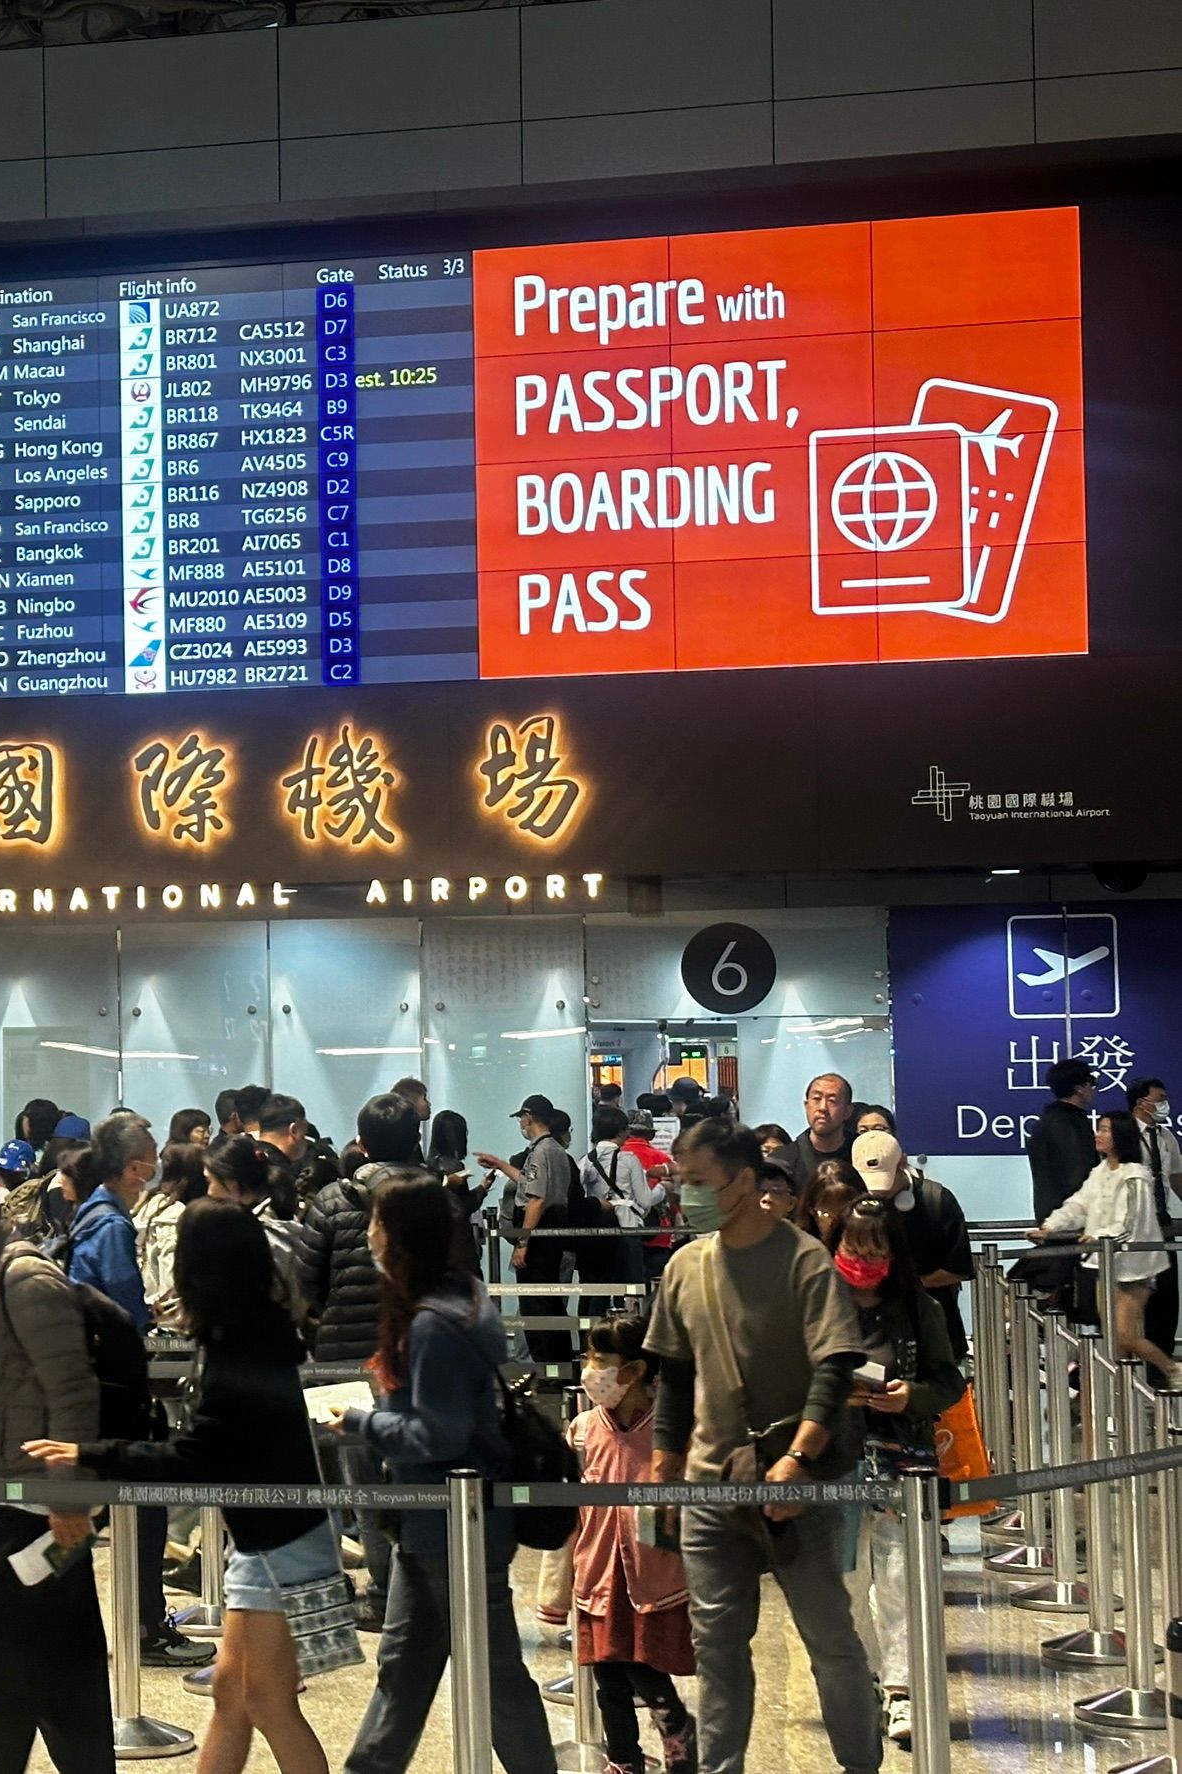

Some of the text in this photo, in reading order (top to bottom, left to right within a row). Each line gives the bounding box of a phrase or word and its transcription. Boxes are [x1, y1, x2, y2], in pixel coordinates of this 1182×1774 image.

[119, 279, 163, 300] Flight
[166, 277, 197, 294] info
[316, 268, 355, 284] Gate
[378, 264, 428, 280] Status
[443, 258, 465, 276] 3/3
[513, 275, 785, 345] Prepare with
[13, 334, 85, 356] Shanghai
[165, 326, 217, 345] BR712
[239, 320, 305, 341] CA5512
[324, 318, 347, 335] D7
[13, 389, 61, 409] Tokyo
[164, 380, 212, 399] JL802
[240, 373, 312, 394] MH9796
[325, 372, 347, 389] D3
[354, 372, 386, 388] est.
[389, 366, 437, 386] 10:25
[515, 360, 800, 435] PASSPORT,
[14, 442, 58, 460] Hong
[61, 439, 103, 458] Kong
[166, 432, 219, 451] BR867
[241, 426, 307, 446] HX1823
[320, 425, 355, 442] C5R
[517, 461, 775, 536] BOARDING
[16, 543, 84, 565] Bangkok
[168, 537, 220, 555] BR201
[241, 533, 301, 552] AI7065
[327, 531, 350, 548] C1
[518, 570, 652, 635] PASS
[17, 623, 74, 640] Fuzhou
[169, 616, 227, 634] MF880
[243, 612, 308, 631] AE5109
[329, 611, 352, 627] D5
[968, 791, 1075, 810] 桃園國際機場
[969, 808, 1111, 822] Taoyuan International Airport
[366, 872, 606, 904] AIRPORT
[710, 940, 749, 997] 6
[1006, 1034, 1136, 1093] 出發
[117, 1485, 301, 1503] 桃園國際機場股份有限公司
[306, 1488, 368, 1505] 機場保全
[371, 1491, 416, 1505] Taoyuan
[627, 1485, 817, 1502] 桃園國際機場股份有限公司
[821, 1484, 886, 1501] 機場保全
